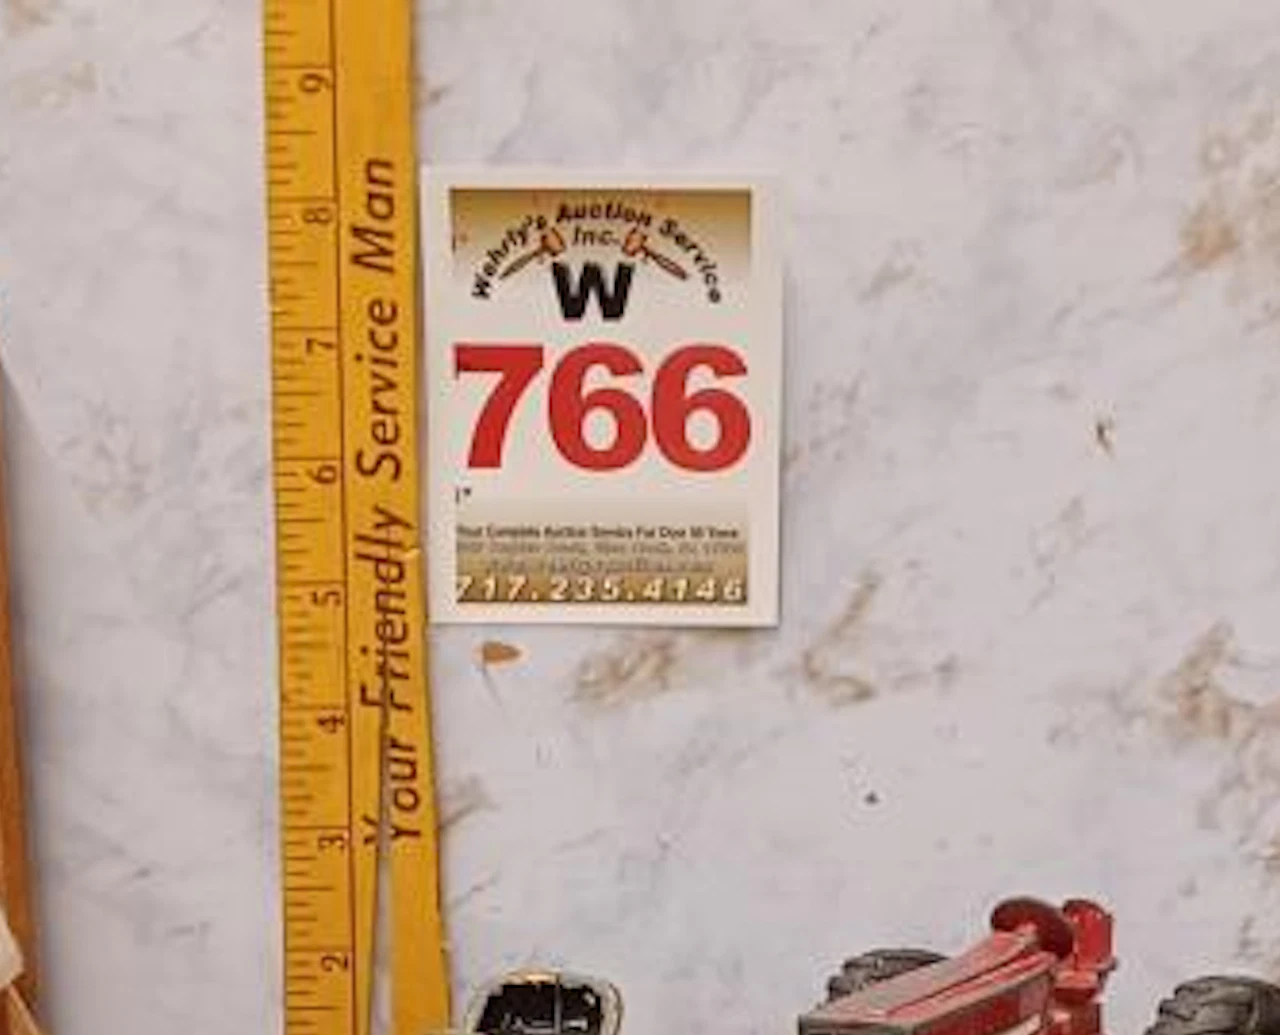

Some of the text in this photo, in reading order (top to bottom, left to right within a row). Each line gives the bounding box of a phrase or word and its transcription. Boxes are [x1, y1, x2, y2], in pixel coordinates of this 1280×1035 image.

[299, 73, 333, 93] 9
[303, 206, 334, 225] 8
[571, 226, 621, 248] Inc.
[471, 201, 723, 303] Wehrly's Auction Service
[552, 261, 637, 321] W
[305, 337, 335, 355] 7
[453, 341, 752, 473] 766
[307, 463, 338, 485] 6
[349, 157, 422, 846] Your Friendly Service Man
[311, 590, 342, 607] 5
[316, 712, 346, 735] 4
[317, 834, 346, 852] 3
[320, 953, 349, 973] 2
